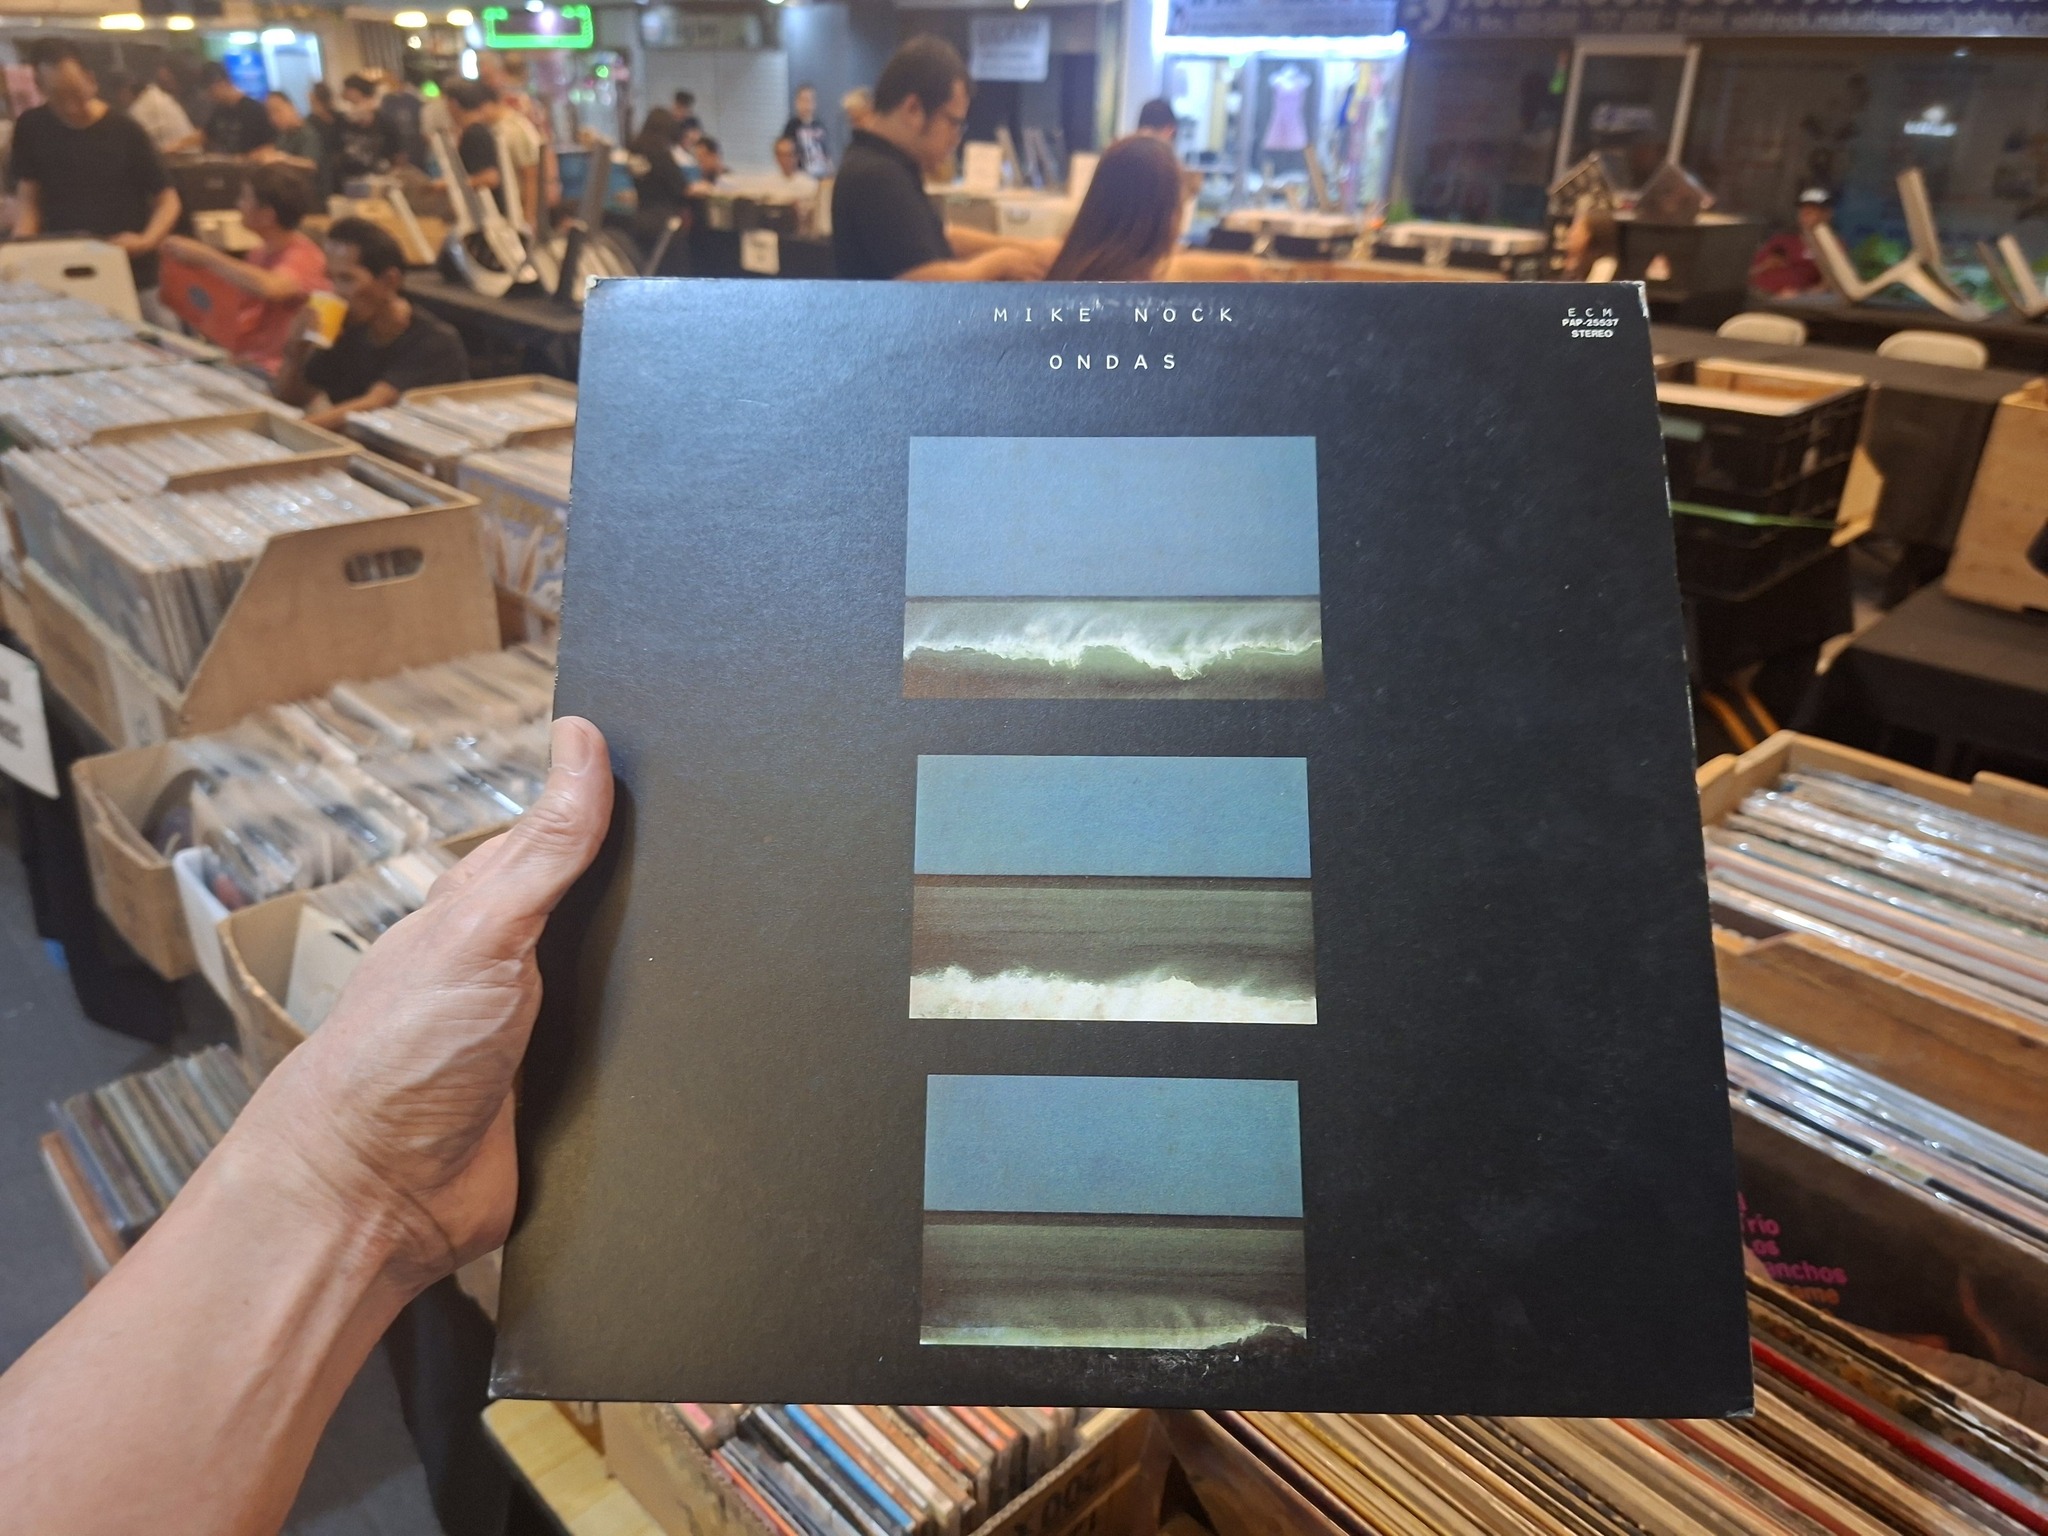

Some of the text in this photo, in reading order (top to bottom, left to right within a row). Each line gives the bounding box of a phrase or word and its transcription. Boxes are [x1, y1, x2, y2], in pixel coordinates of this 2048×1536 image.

[993, 307, 1233, 323] MIKE NOCK
[1571, 329, 1614, 338] STEREO
[1049, 354, 1175, 370] ONDAS
[1744, 1214, 1780, 1236] rio
